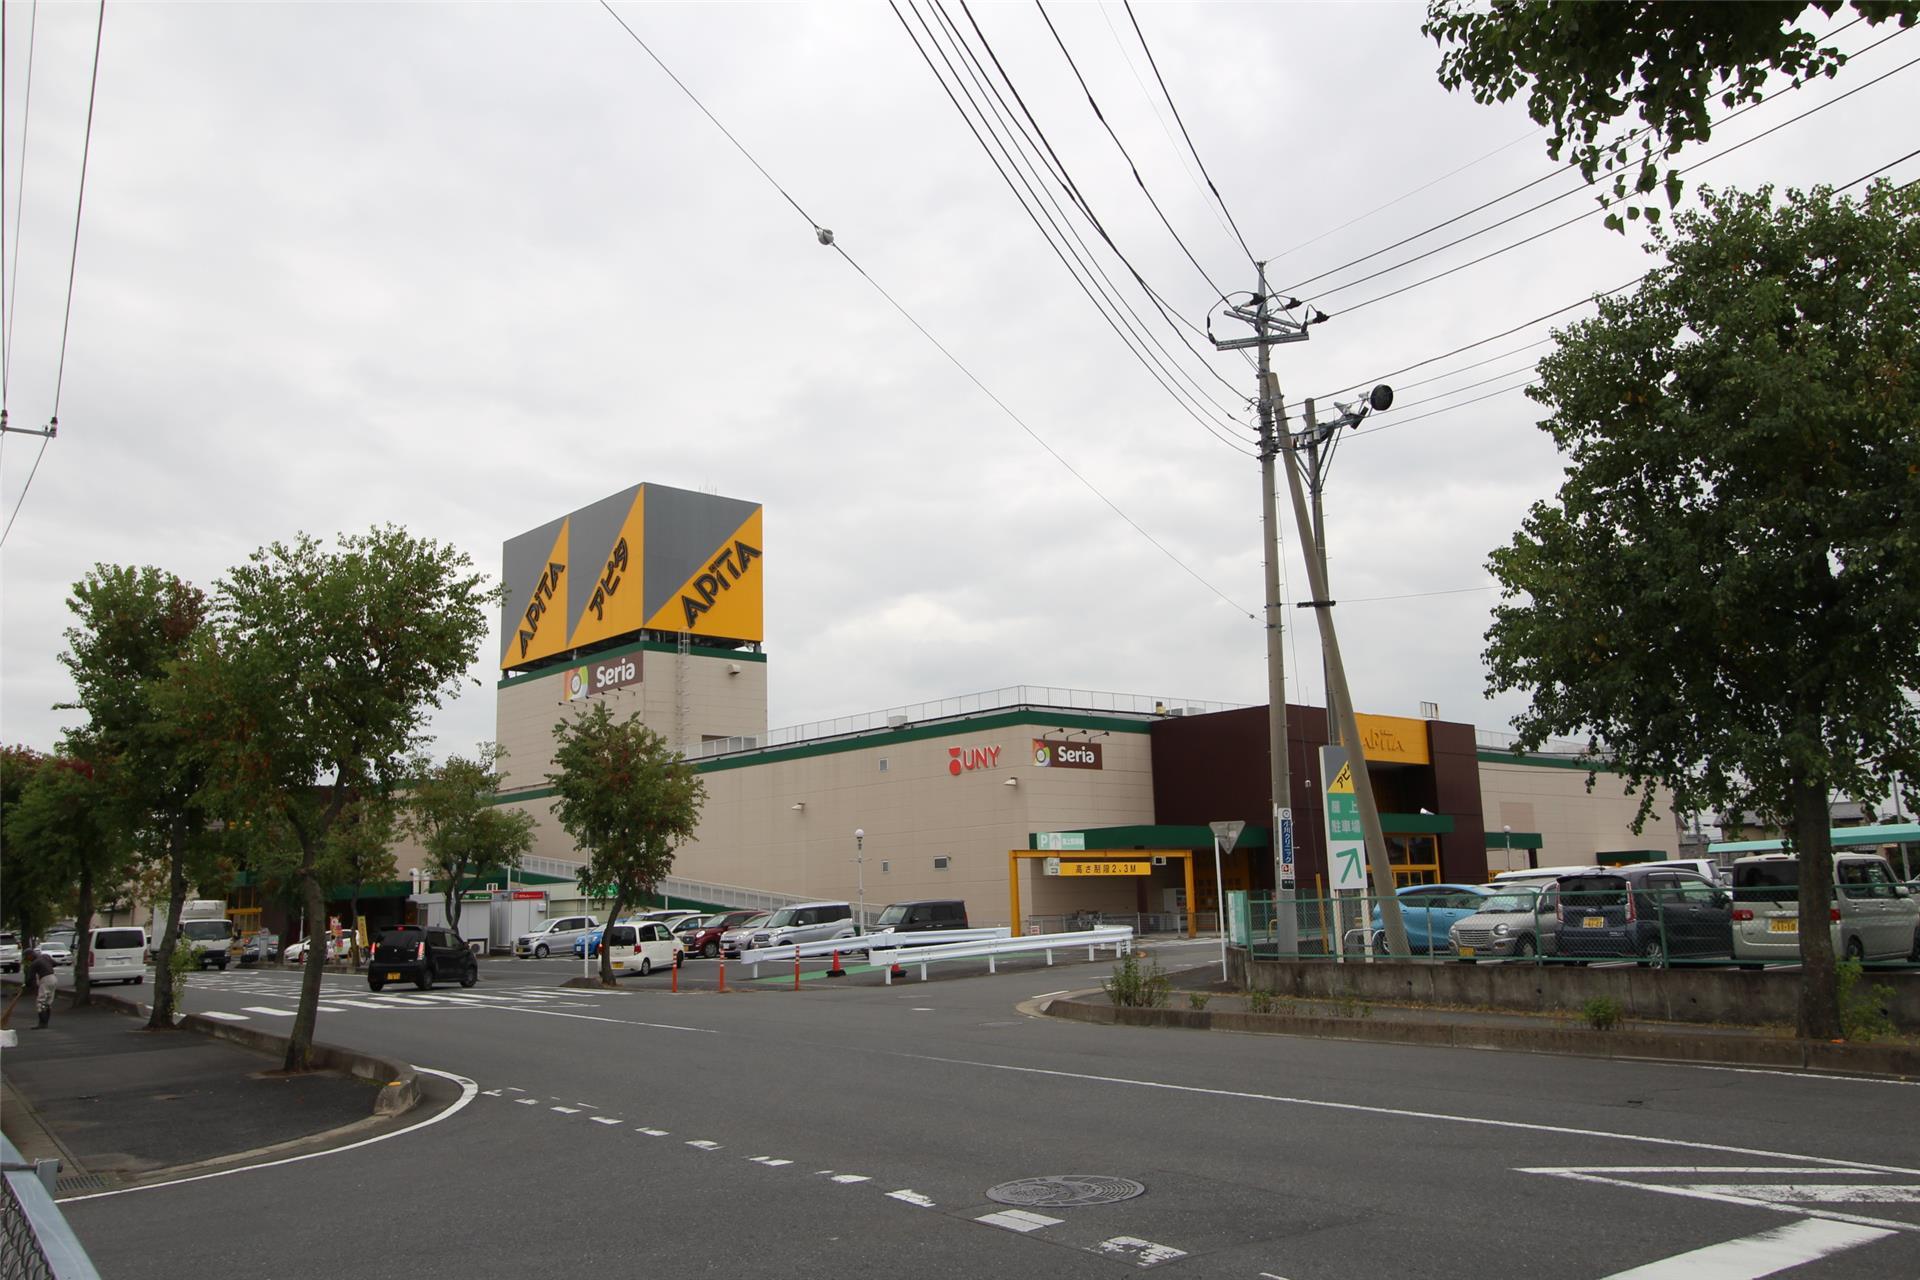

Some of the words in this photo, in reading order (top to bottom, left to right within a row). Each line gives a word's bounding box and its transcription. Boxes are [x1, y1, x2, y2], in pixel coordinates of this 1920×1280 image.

[588, 536, 629, 621] アピタ
[596, 658, 636, 688] Seria
[963, 745, 1002, 771] UNY
[1057, 745, 1096, 764] Seria
[1336, 764, 1351, 789] アピ
[1040, 834, 1049, 848] P
